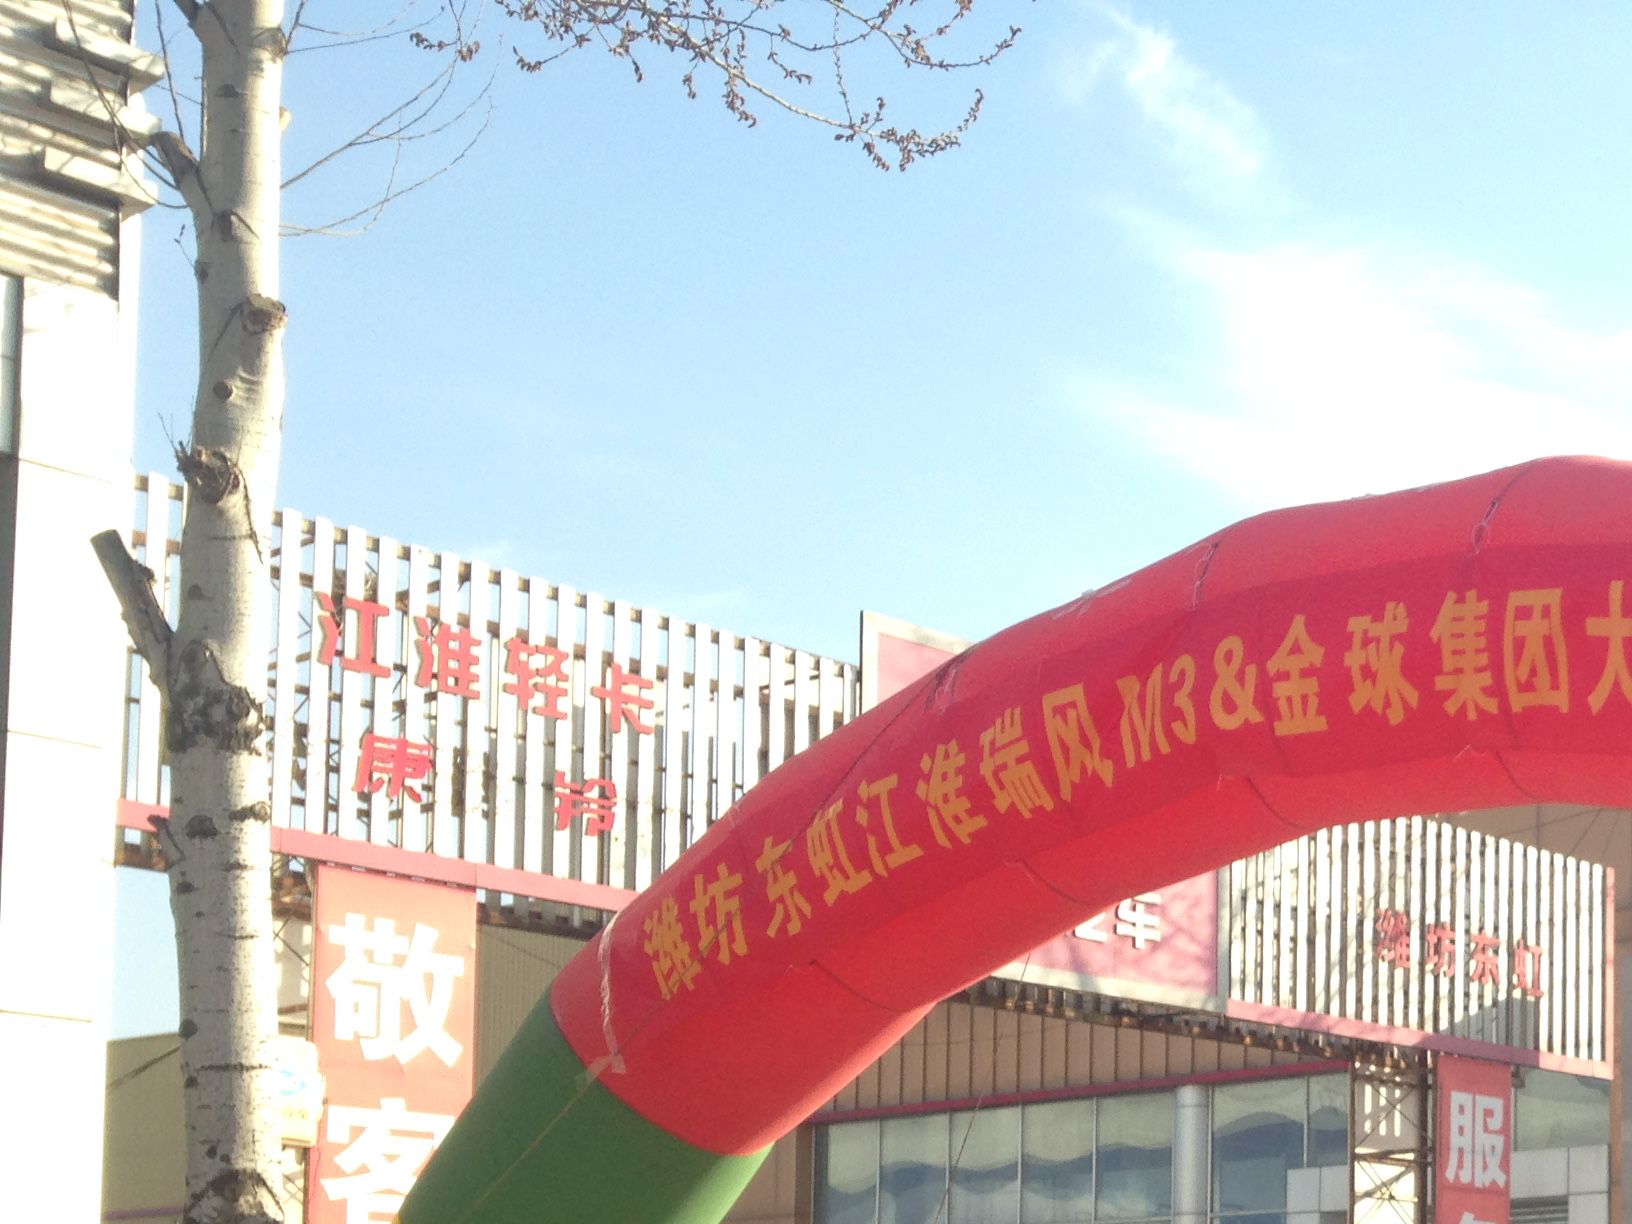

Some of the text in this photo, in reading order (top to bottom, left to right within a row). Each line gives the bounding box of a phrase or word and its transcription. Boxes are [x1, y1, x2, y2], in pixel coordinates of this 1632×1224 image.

[314, 590, 656, 736] 江淮轻卡
[351, 731, 619, 836] 康铃
[1072, 891, 1163, 950] 车
[1376, 907, 1544, 998] 潍坊东虹
